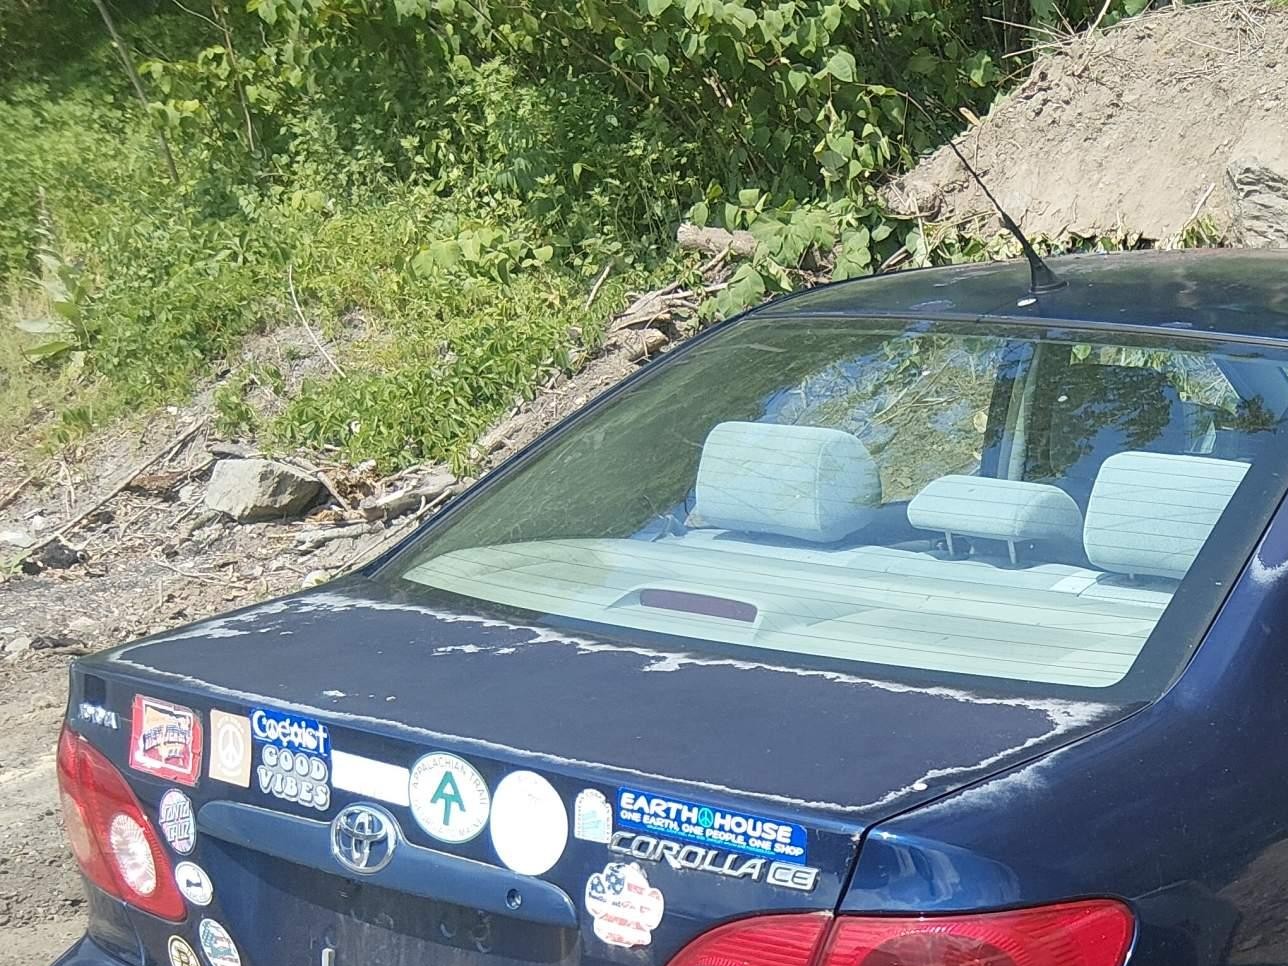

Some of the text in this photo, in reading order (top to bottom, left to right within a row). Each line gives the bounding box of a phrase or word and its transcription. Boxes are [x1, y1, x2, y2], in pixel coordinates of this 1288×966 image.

[262, 745, 327, 782] GOOD
[412, 756, 466, 788] APPALACHIAN
[258, 767, 329, 808] VIBES
[161, 801, 190, 823] SANTA
[168, 820, 190, 842] CRUZ
[620, 792, 698, 824] EARTH
[713, 812, 792, 844] HOUSE
[620, 810, 641, 823] ONE
[682, 823, 705, 836] ONE
[748, 838, 772, 851] ONE
[773, 842, 804, 857] SHOP
[608, 831, 767, 881] COROLLA
[769, 863, 817, 890] CE
